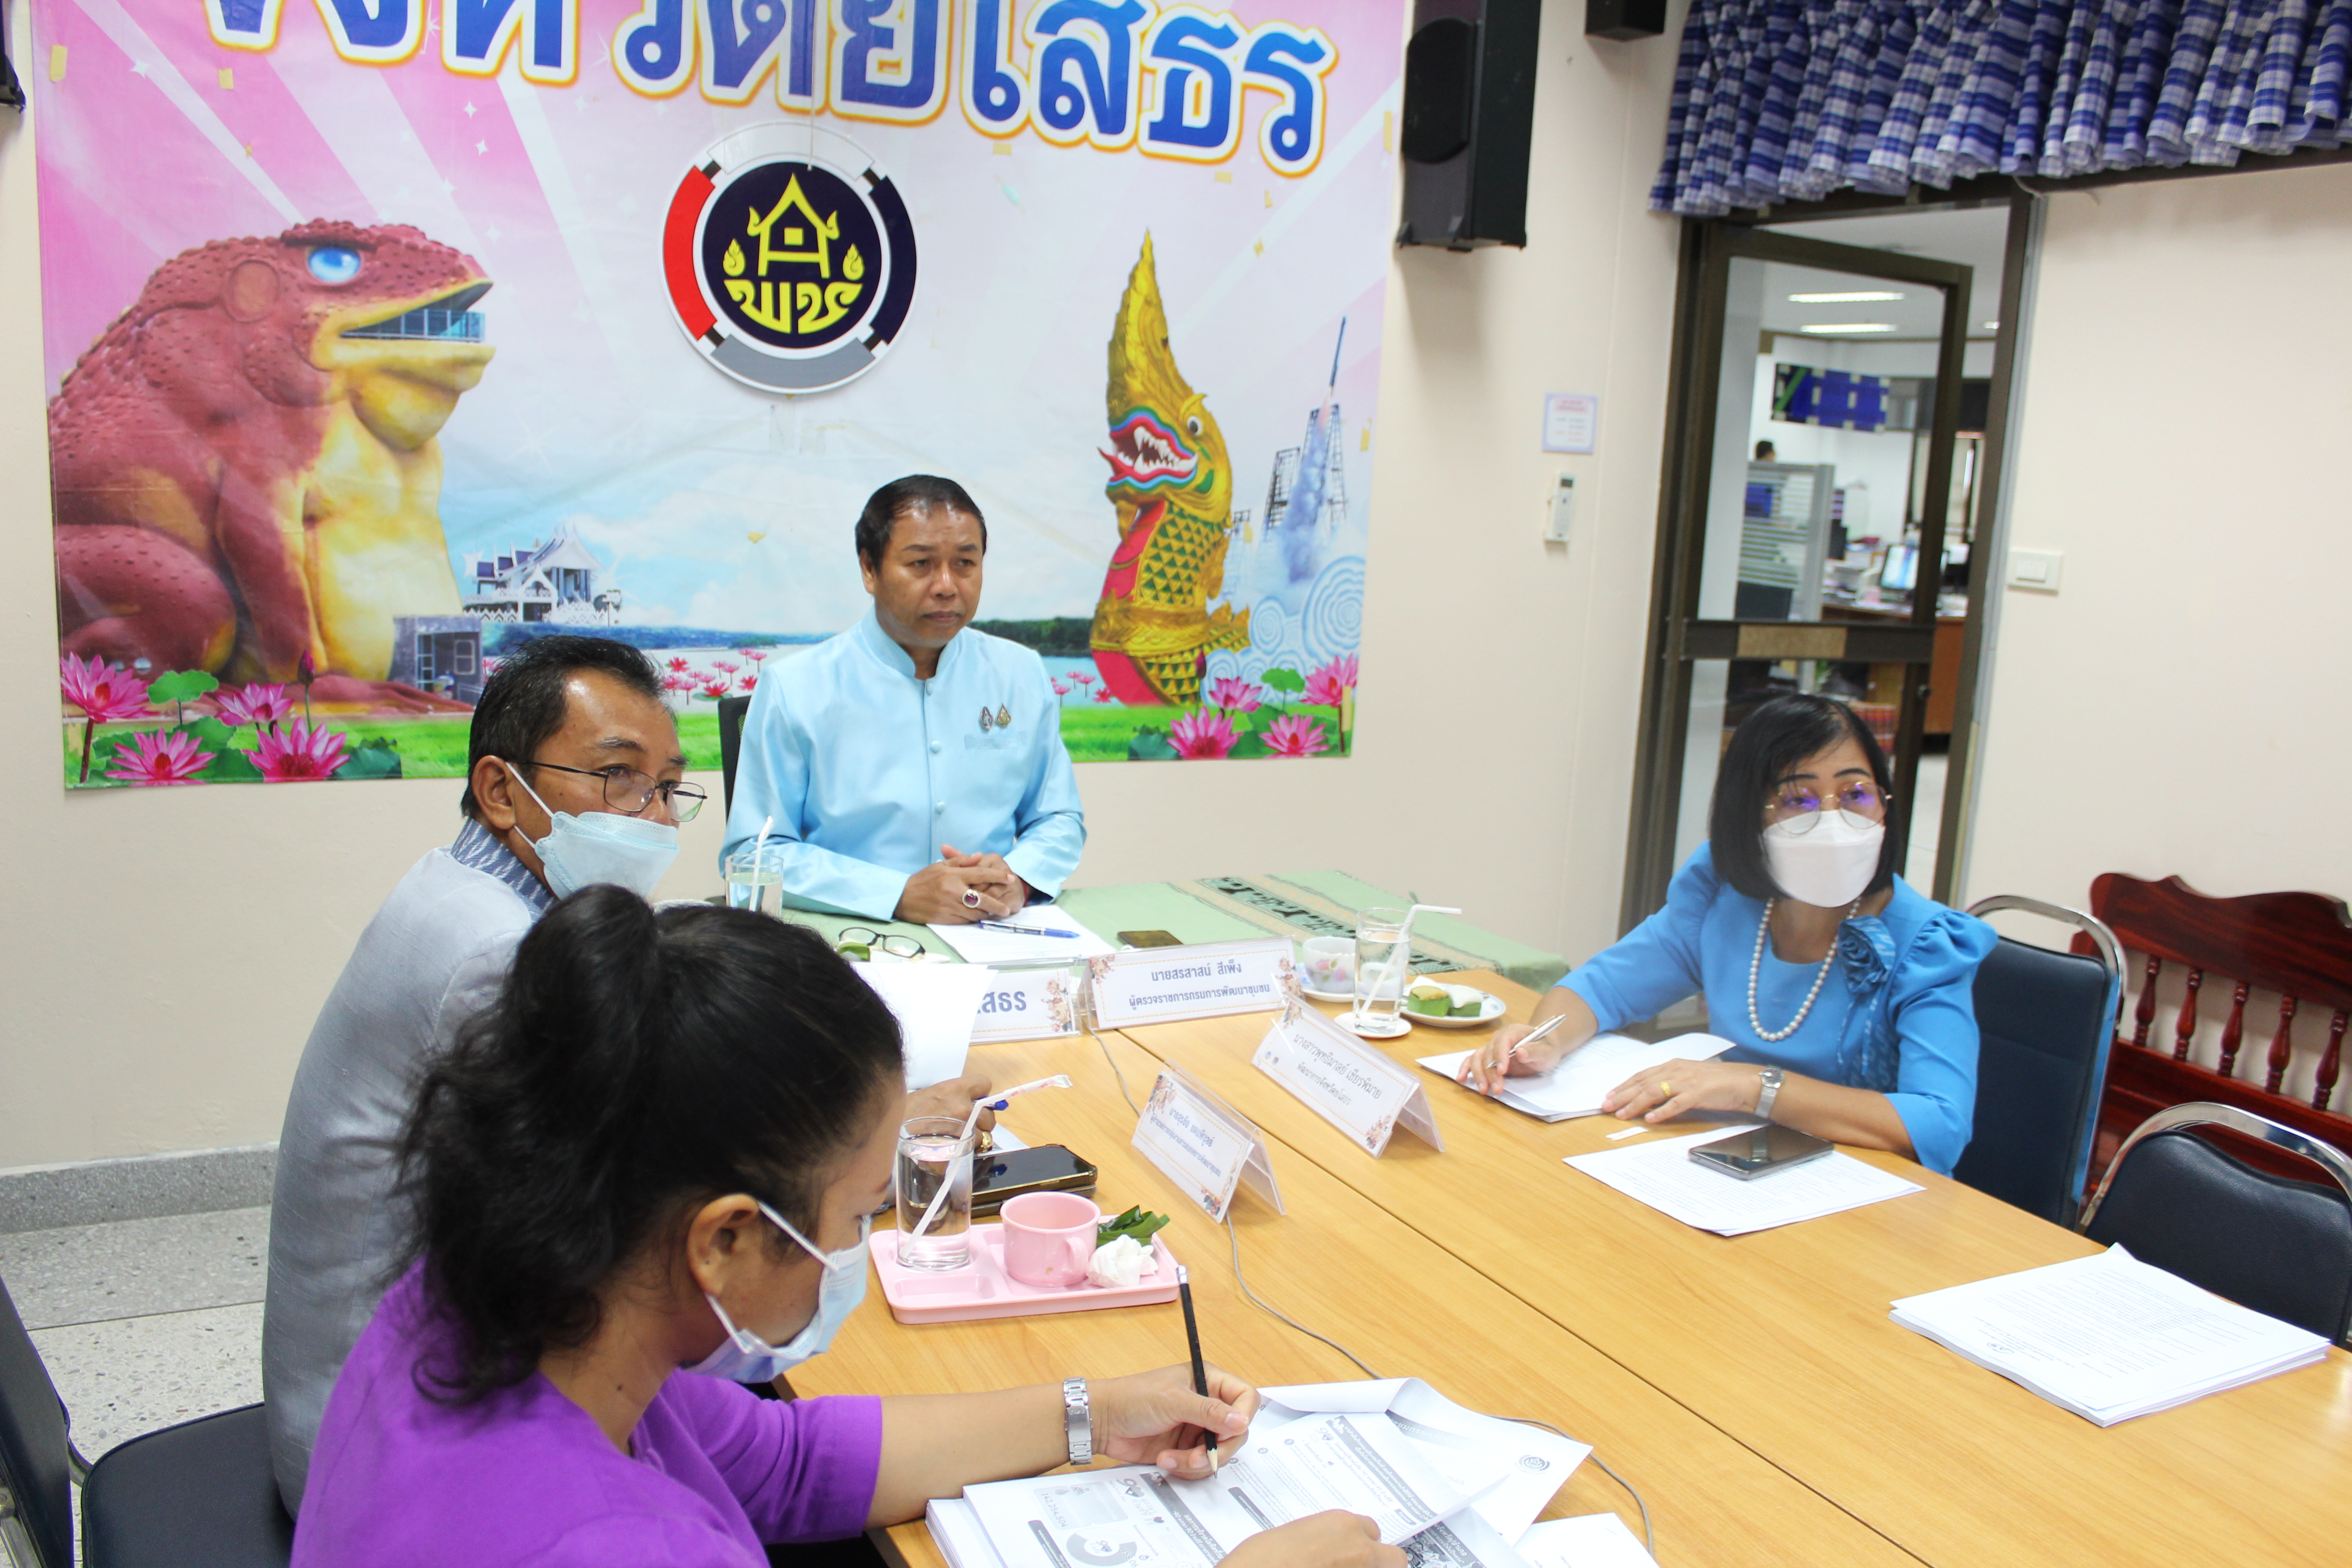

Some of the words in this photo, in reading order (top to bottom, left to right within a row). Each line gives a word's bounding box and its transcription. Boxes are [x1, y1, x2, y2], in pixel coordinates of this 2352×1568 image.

[1151, 963, 1211, 981] นายสรสาสน์
[1217, 959, 1242, 975] สีเพ็ง
[977, 991, 1027, 1014] สธร
[1129, 984, 1270, 1010] ผู้ตรวจราชการกรมการพัฒนาชุมชน
